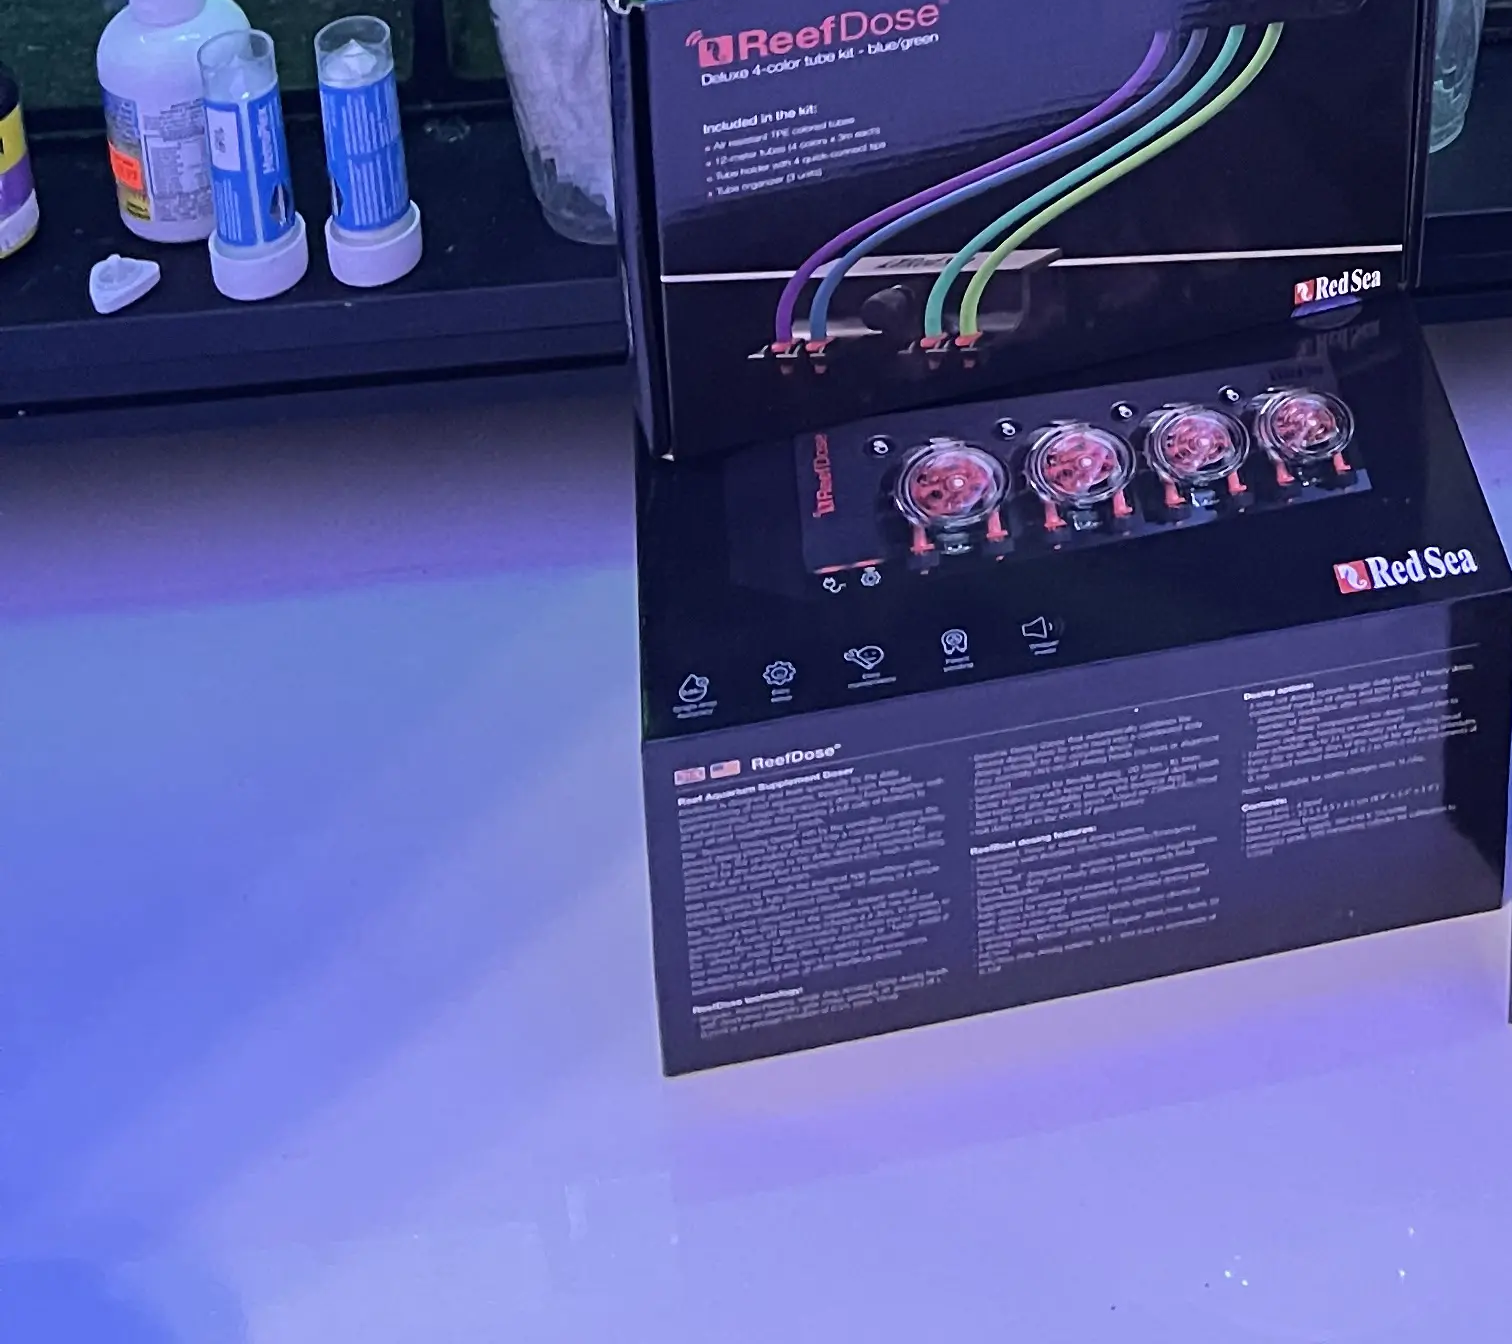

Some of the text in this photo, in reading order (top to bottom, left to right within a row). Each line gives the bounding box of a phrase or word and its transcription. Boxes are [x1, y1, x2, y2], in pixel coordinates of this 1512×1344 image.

[701, 67, 749, 87] Deluxe
[752, 58, 801, 77] 4-color
[804, 51, 836, 67] tube
[838, 47, 855, 62] kit
[867, 32, 940, 55] blue/green
[703, 104, 818, 135] Included in the kit:
[1314, 268, 1381, 301] Red Sea
[1364, 546, 1478, 590] Red Sea
[704, 786, 756, 802] Aquarium
[757, 773, 821, 791] Supplement
